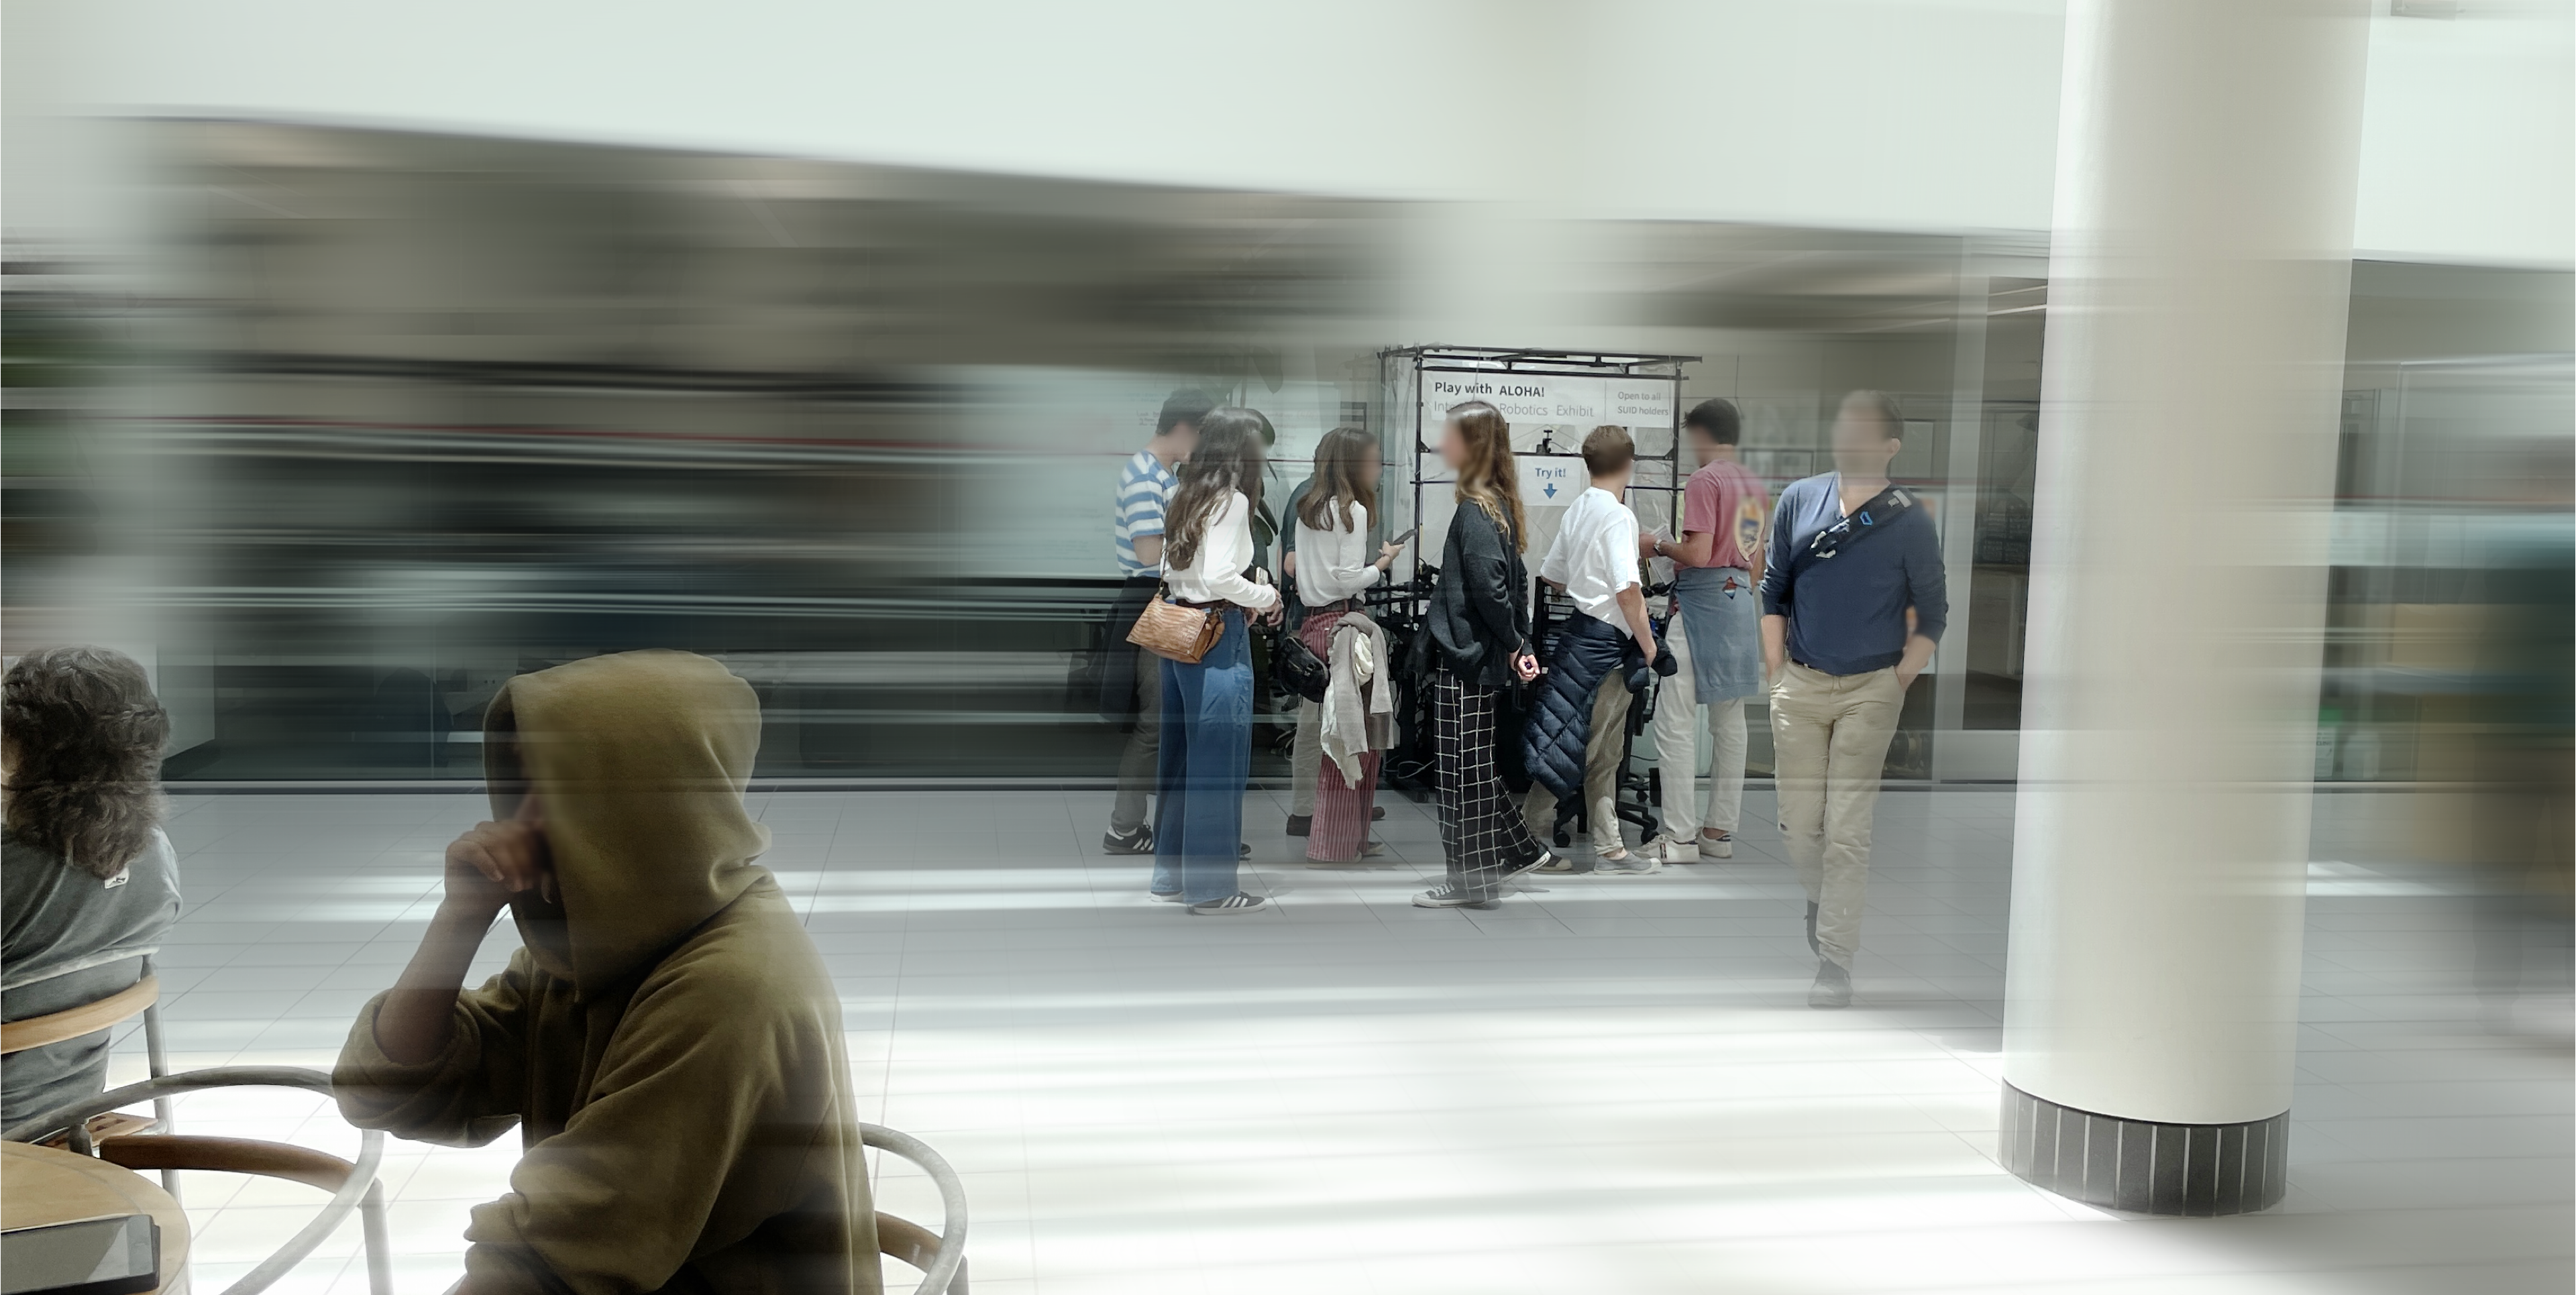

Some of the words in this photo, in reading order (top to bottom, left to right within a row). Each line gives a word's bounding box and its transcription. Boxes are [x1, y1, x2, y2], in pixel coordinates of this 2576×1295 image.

[1435, 382, 1462, 396] Play
[1464, 382, 1492, 394] with
[1499, 385, 1544, 398] ALOHA!
[1617, 391, 1640, 401] Open
[1641, 392, 1650, 400] to
[1651, 392, 1661, 400] all
[1499, 402, 1548, 416] Robotics
[1556, 404, 1595, 417] Exhibit
[1617, 406, 1638, 414] SUID
[1639, 406, 1669, 416] holders
[1535, 467, 1552, 480] Try
[1554, 467, 1566, 478] it!
